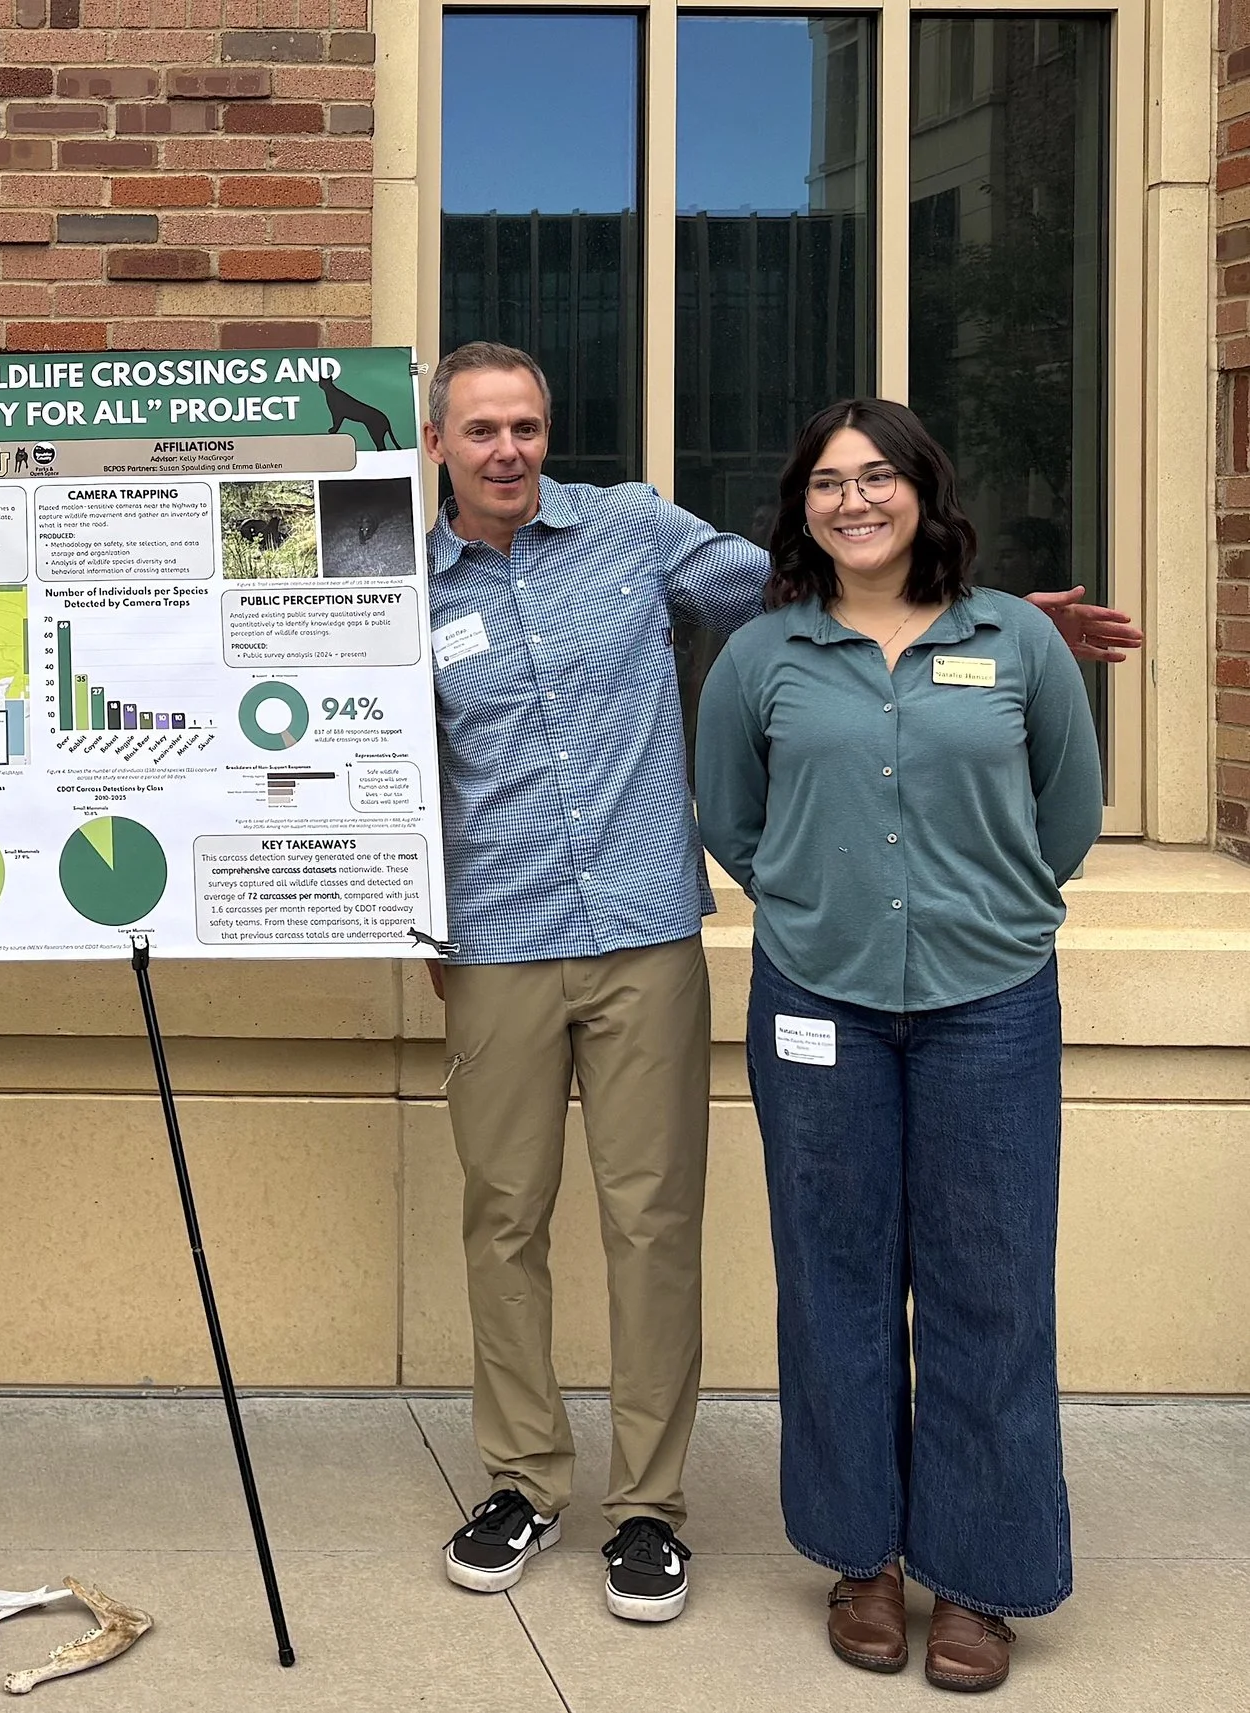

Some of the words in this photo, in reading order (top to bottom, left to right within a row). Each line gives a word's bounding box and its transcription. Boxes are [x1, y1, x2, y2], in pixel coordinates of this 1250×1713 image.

[91, 358, 267, 387] CROSSINGS
[274, 357, 341, 382] AND
[27, 401, 87, 425] FOR
[92, 399, 161, 424] ALL”
[170, 396, 300, 422] PROJECT
[153, 440, 234, 452] AFFILIATIONS
[198, 454, 234, 462] MacGregor
[67, 489, 117, 500] CAMERA
[119, 488, 178, 499] TRAPPING
[45, 587, 84, 597] Number
[86, 587, 96, 596] of
[98, 586, 151, 595] Individuals
[154, 588, 170, 597] per
[173, 586, 208, 597] Species
[64, 599, 105, 608] Detected
[108, 598, 120, 609] by
[122, 598, 161, 606] Camera
[163, 598, 190, 608] Traps
[240, 595, 280, 606] PUBLIC
[283, 594, 353, 605] PERCEPTION
[356, 593, 401, 604] SURVEY
[321, 697, 383, 720] 94%
[56, 736, 70, 750] Deer
[261, 839, 283, 849] KEY
[285, 839, 356, 849] TAKEAWAYS
[249, 853, 285, 861] detection
[287, 854, 313, 863] survey
[314, 852, 354, 862] generated
[372, 852, 381, 860] of
[382, 852, 396, 860] the
[397, 852, 418, 860] most
[211, 866, 270, 876] comprehensive
[302, 865, 336, 873] datasets
[338, 865, 383, 873] nationwide.
[386, 865, 408, 873] These
[208, 881, 237, 889] surveys
[239, 879, 274, 888] captured
[276, 879, 287, 887] all
[289, 878, 318, 886] wildlife
[349, 878, 365, 886] and
[367, 878, 401, 886] detected
[203, 894, 235, 902] average
[237, 892, 245, 900] of
[247, 892, 257, 900] 72
[298, 893, 312, 901] per
[313, 891, 342, 900] month,
[343, 892, 383, 900] compared
[403, 892, 419, 900] just
